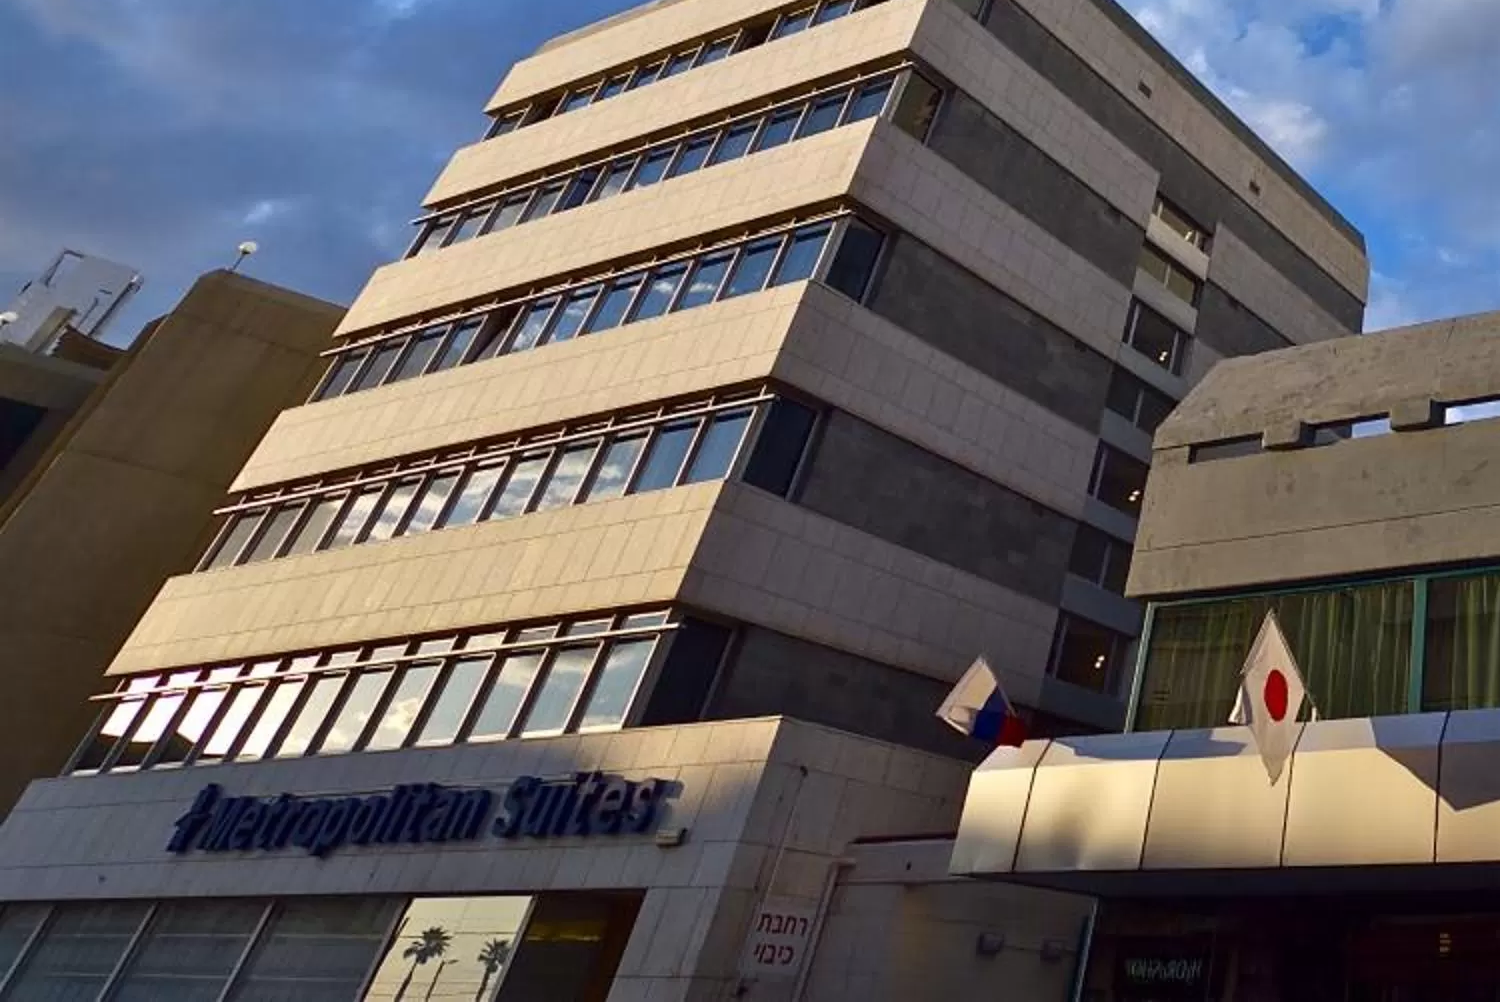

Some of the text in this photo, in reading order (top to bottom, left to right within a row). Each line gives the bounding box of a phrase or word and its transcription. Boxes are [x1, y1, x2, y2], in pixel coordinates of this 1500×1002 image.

[195, 782, 492, 859] Metropolitan
[757, 913, 808, 936] רחבת
[753, 943, 794, 965] כיבוי
